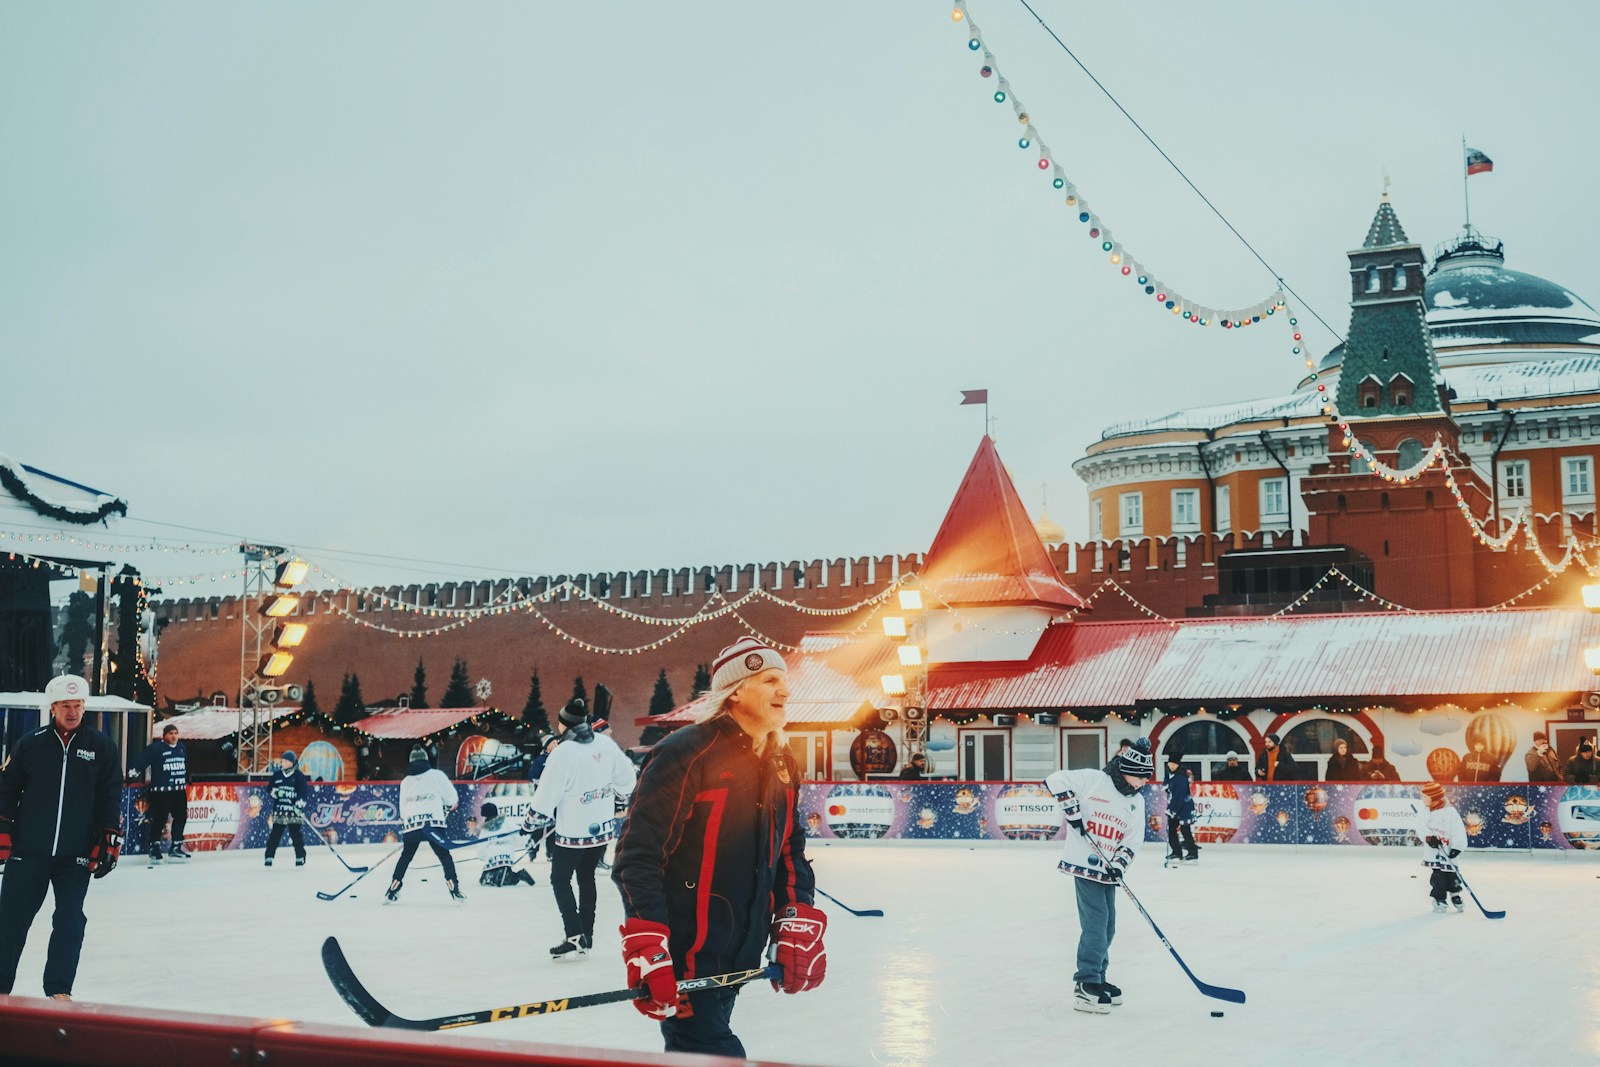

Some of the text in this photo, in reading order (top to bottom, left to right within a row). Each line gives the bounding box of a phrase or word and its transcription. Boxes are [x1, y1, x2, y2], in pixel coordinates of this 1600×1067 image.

[1018, 804, 1055, 812] TISSOT
[1382, 810, 1417, 818] masterc
[490, 998, 569, 1022] CCM
